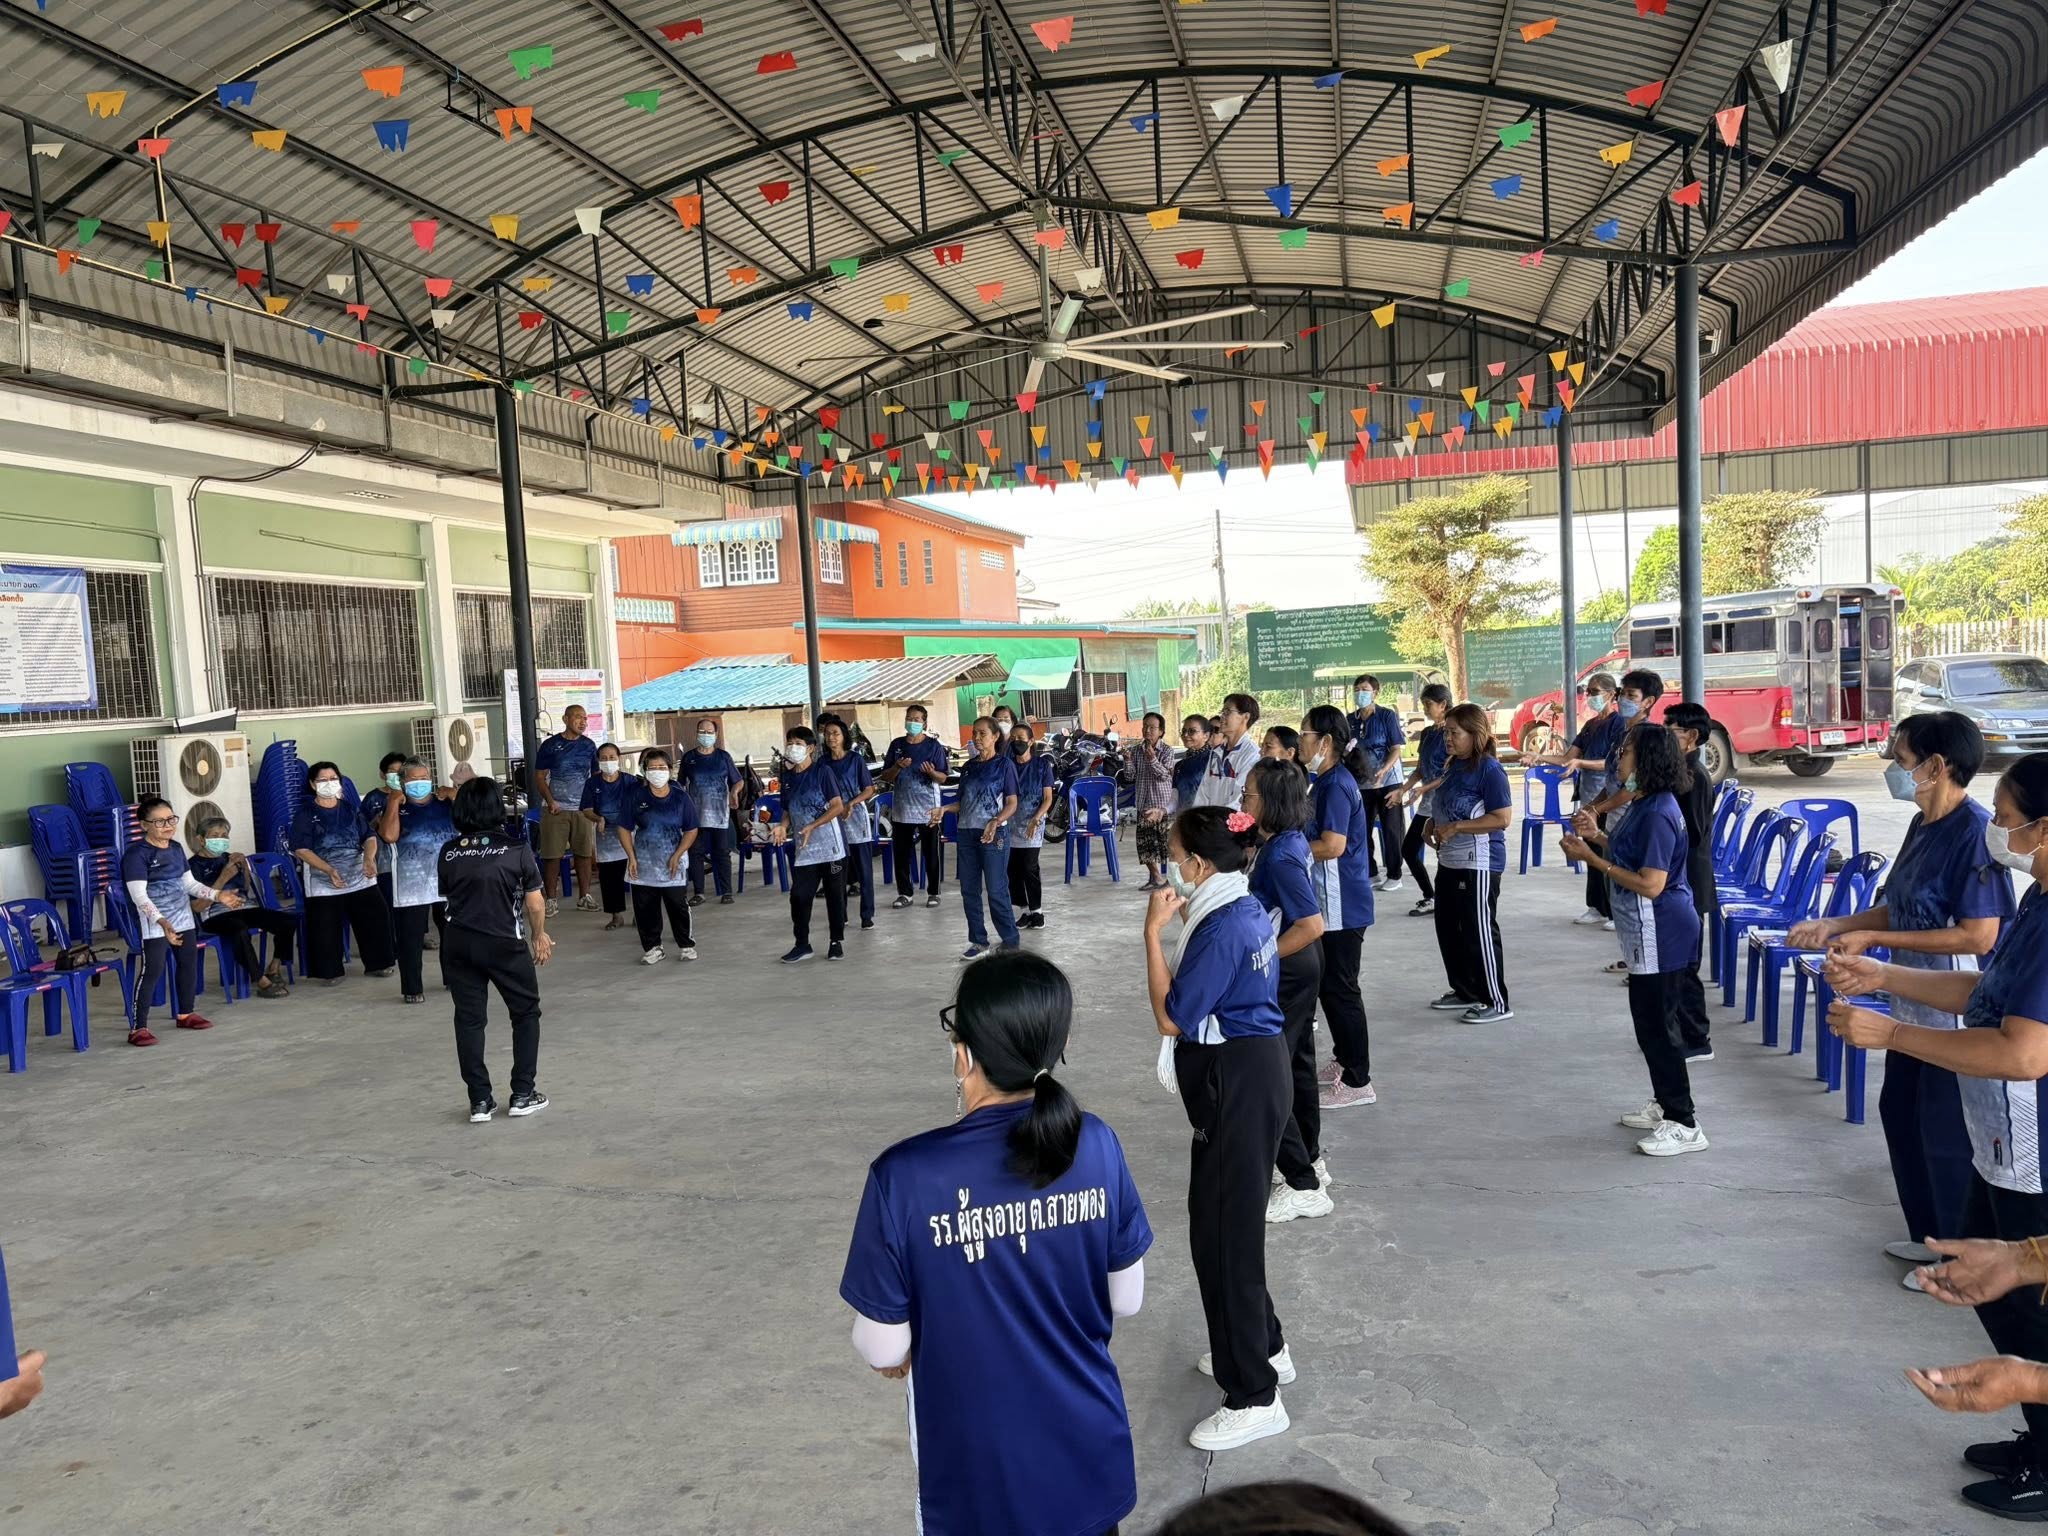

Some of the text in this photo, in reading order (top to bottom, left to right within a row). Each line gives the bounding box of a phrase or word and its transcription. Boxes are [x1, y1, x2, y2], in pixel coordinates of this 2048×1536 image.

[929, 1187, 1106, 1263] รร.ผู้สูงอายุ ต.สายทอง
